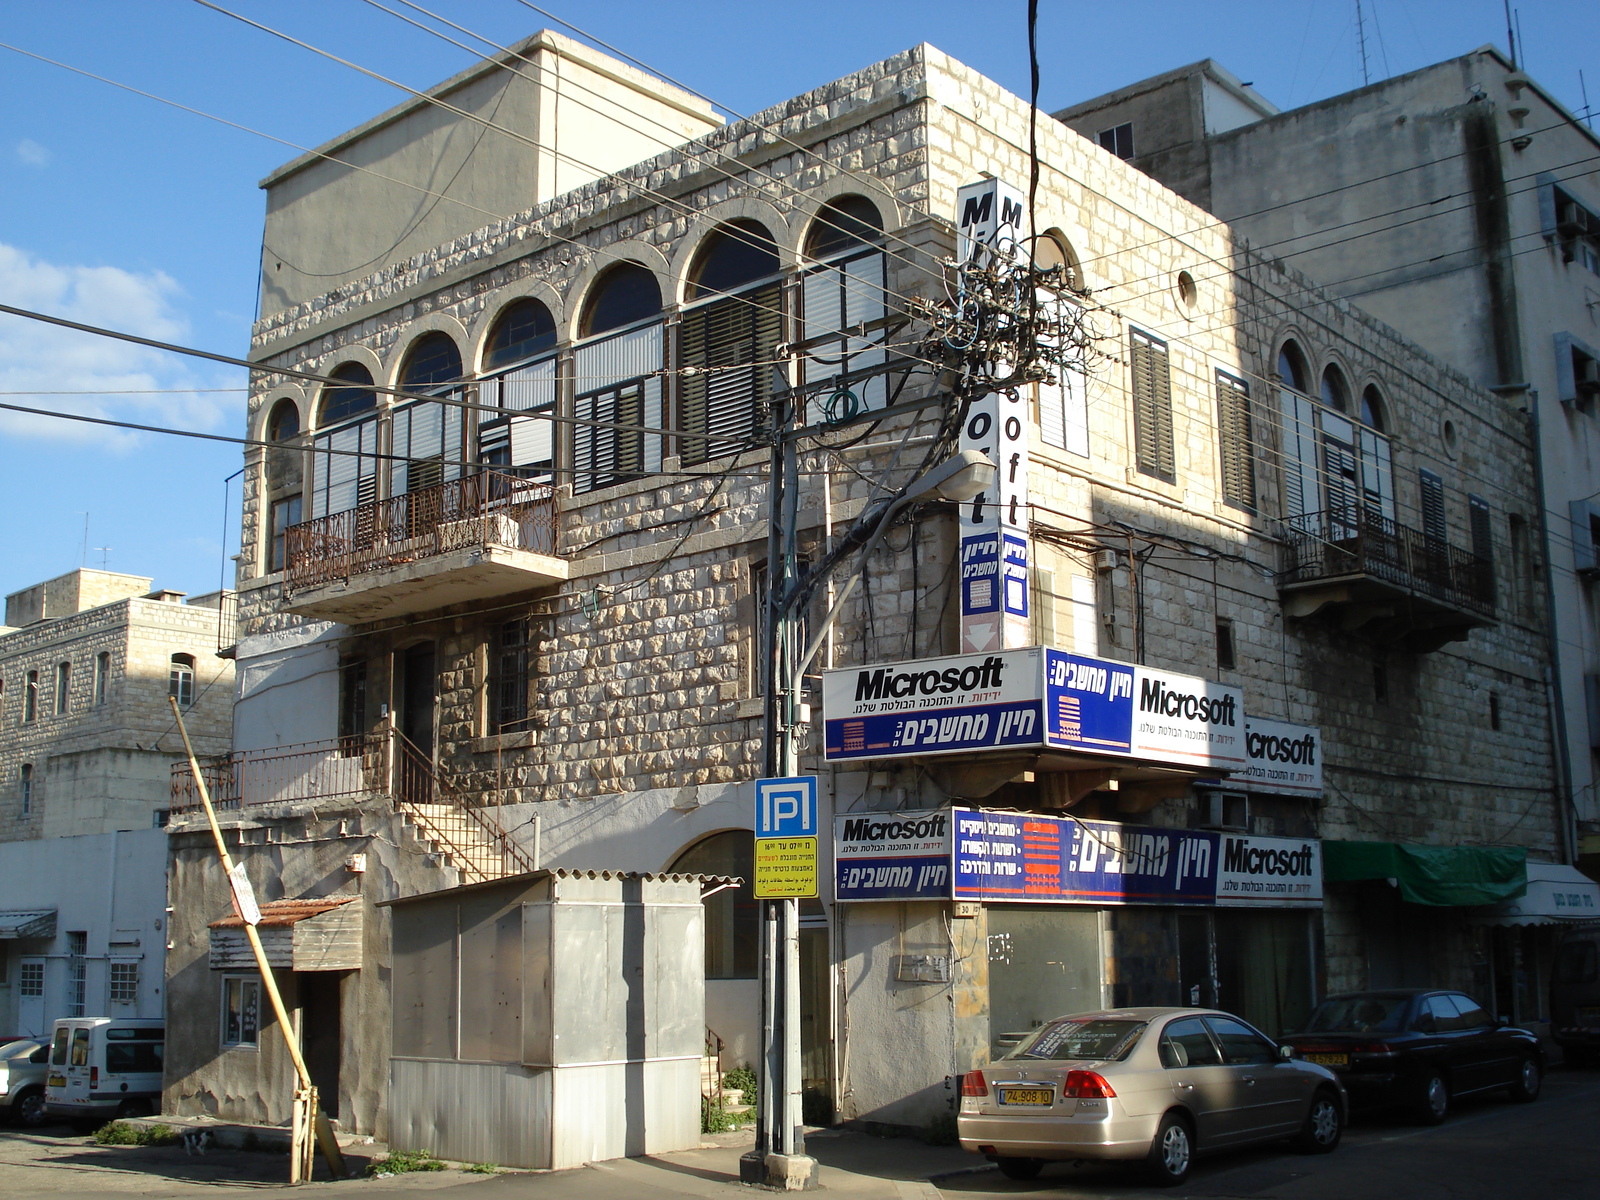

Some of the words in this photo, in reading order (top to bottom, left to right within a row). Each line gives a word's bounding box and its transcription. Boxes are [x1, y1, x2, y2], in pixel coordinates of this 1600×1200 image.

[963, 540, 997, 562] חיון
[1003, 541, 1026, 560] חיון
[963, 561, 997, 578] מחשבים
[854, 657, 1004, 701] Microsoft
[1055, 660, 1107, 695] מחשבים
[1109, 671, 1133, 702] חיון
[880, 699, 915, 712] הבולטת
[919, 695, 953, 707] התוכנה
[958, 694, 965, 704] זו
[968, 691, 1001, 703] ידידות.
[1139, 677, 1236, 727] Microsoft
[852, 703, 876, 714] שלנו.
[901, 713, 989, 746] מחשבים
[994, 708, 1035, 745] חיון
[1158, 725, 1182, 738] הבולטת
[1185, 729, 1207, 741] התוכנה
[1246, 724, 1315, 766] icrosoft
[842, 814, 946, 842] Microsoft
[778, 842, 787, 850] עד
[860, 844, 885, 852] הבולטת
[887, 843, 911, 851] התוכנה
[921, 842, 943, 850] ידידות.
[1078, 829, 1170, 878] מחשבים
[960, 859, 991, 875] והדרכה
[1175, 836, 1212, 891] חיון
[1224, 838, 1313, 877] Microsoft
[847, 866, 913, 889] מחשבים
[916, 864, 948, 892] חיון
[993, 862, 1016, 876] שרות
